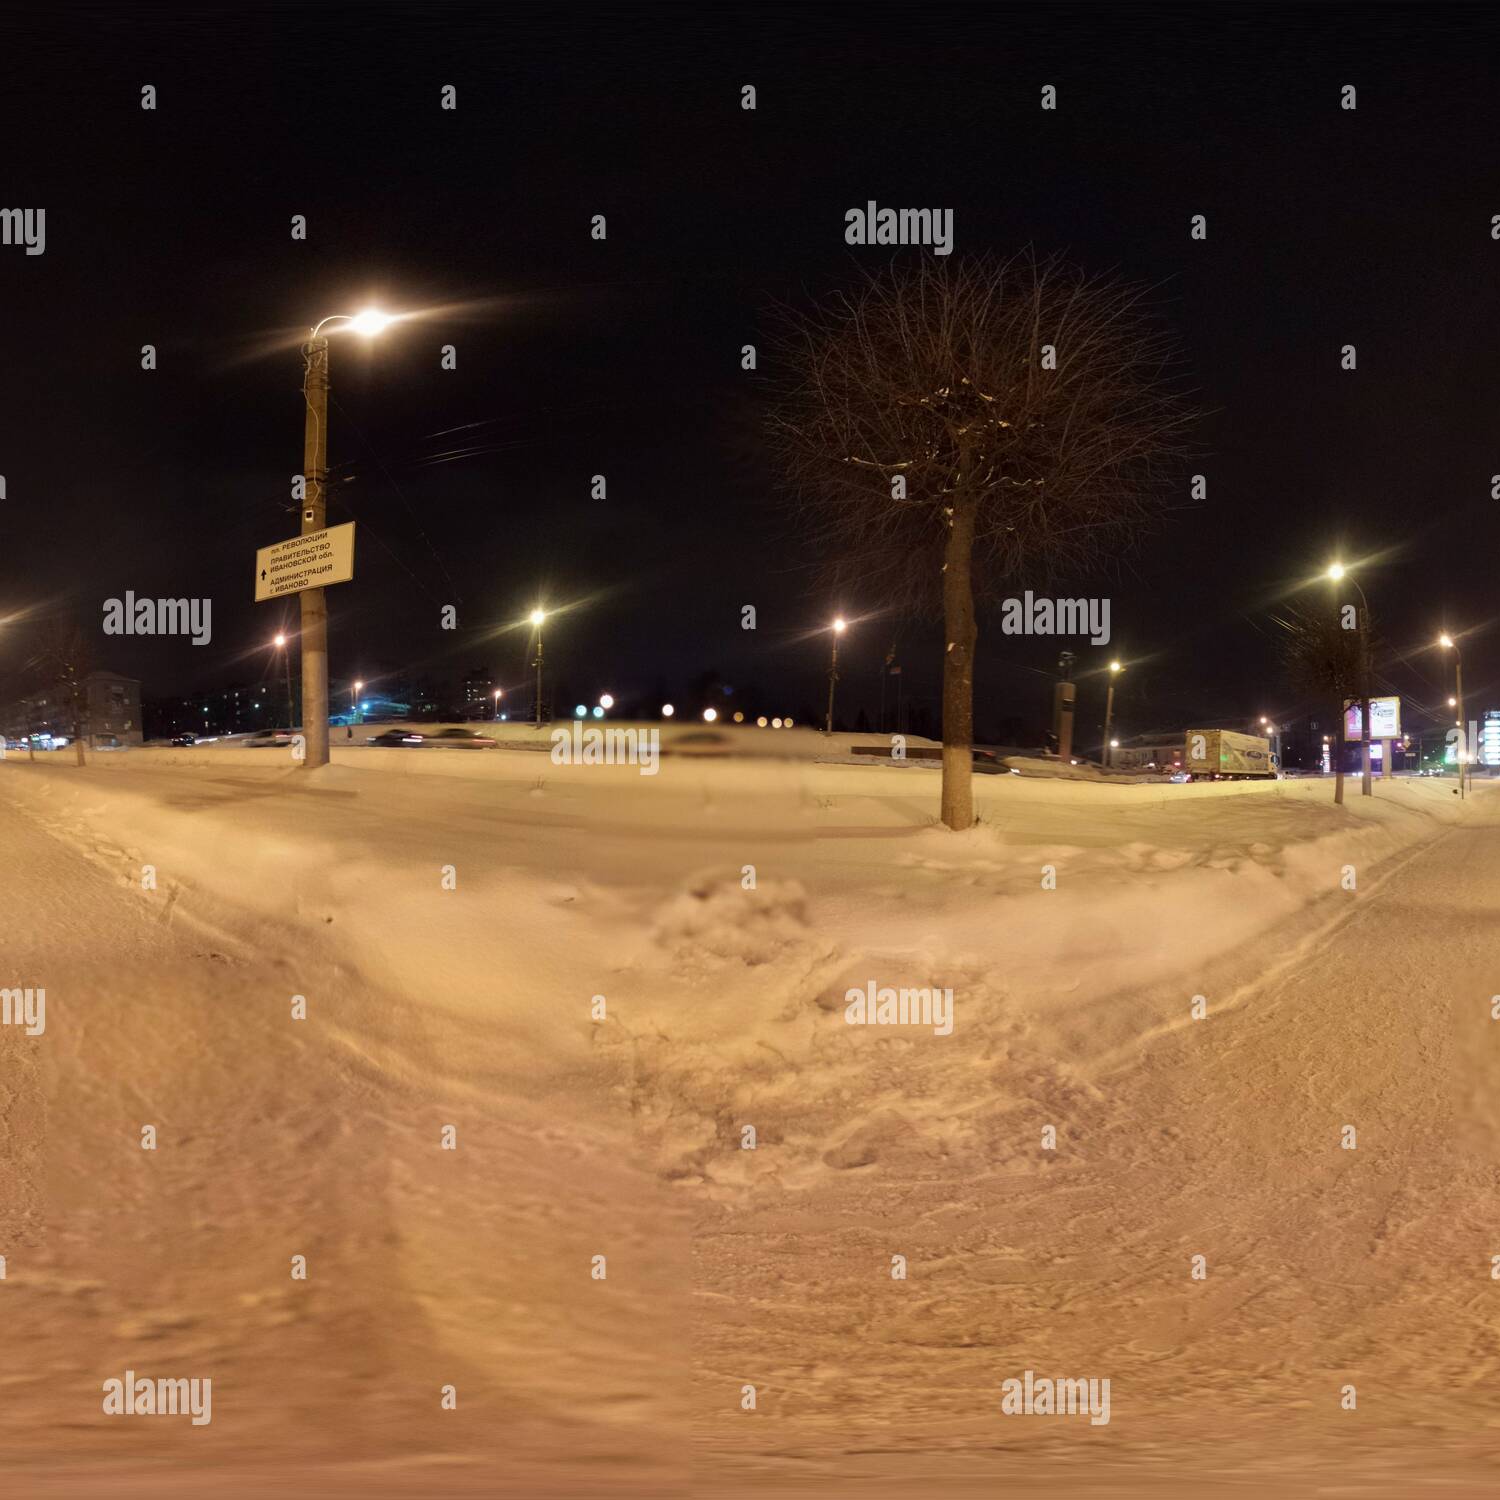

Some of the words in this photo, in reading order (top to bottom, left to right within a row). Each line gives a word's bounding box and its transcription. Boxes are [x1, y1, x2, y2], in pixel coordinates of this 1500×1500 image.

[282, 532, 328, 551] РЕВОЛЮЦИИ
[270, 542, 331, 565] ПРАВИТЕЛЬСТВО
[270, 556, 317, 573] ИВАНОВСКОЙ
[270, 564, 333, 586] АДМИНИСТРАЦИЯ
[275, 579, 309, 593] ИВАНОВО
